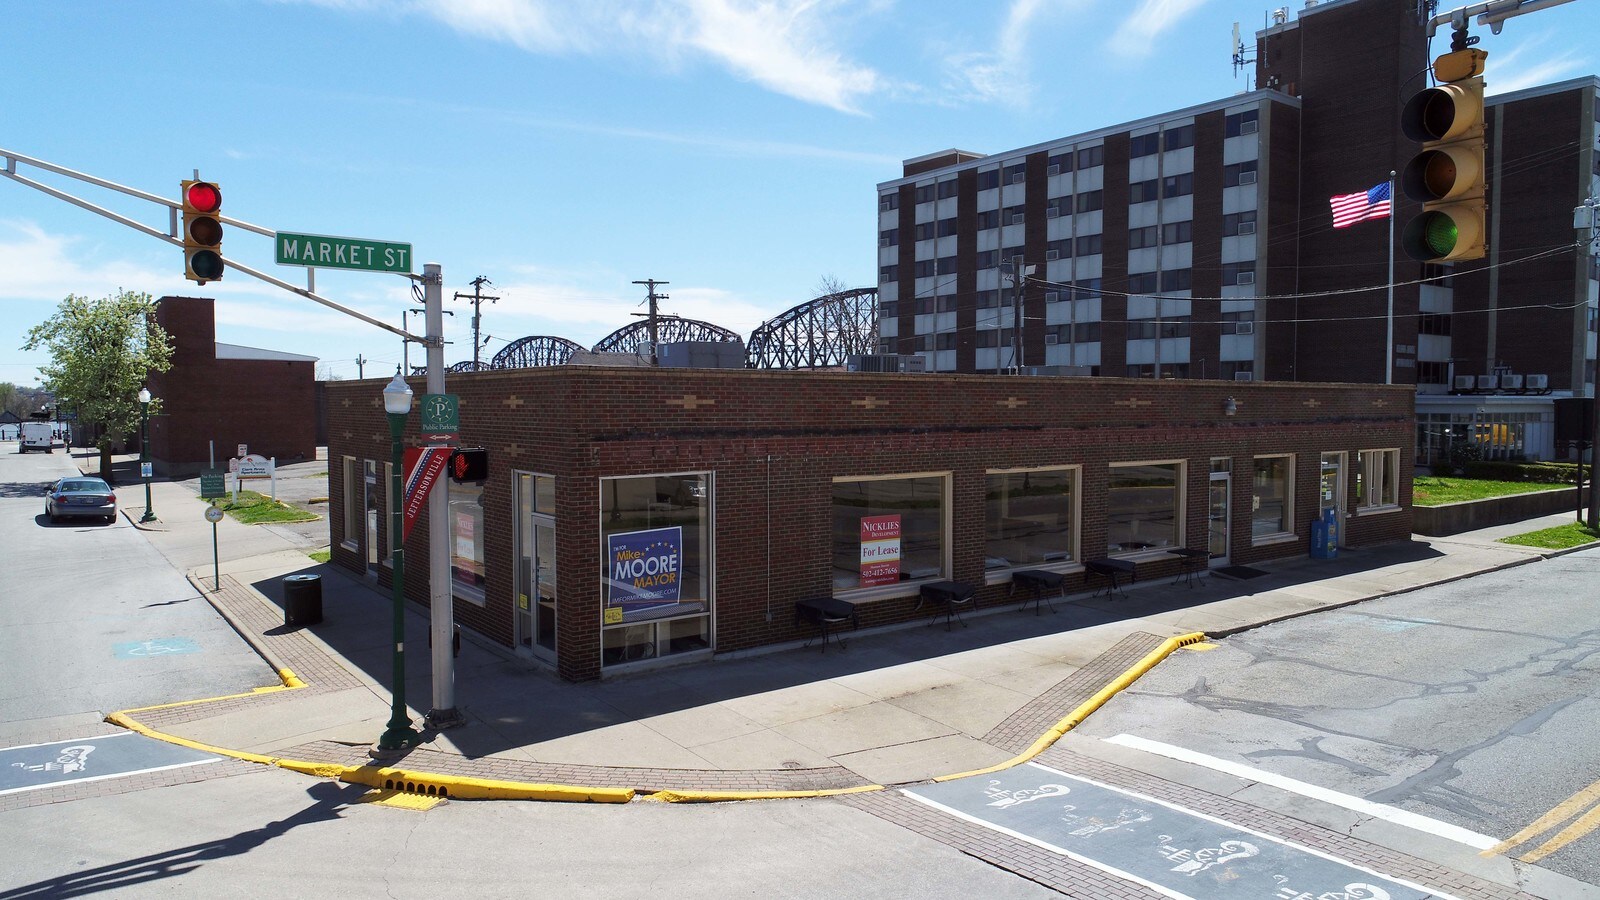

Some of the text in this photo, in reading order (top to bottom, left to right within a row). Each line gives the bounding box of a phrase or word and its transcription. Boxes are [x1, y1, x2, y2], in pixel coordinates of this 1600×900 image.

[283, 239, 407, 268] MARKET ST
[435, 403, 446, 417] P
[422, 423, 458, 432] Public Parking
[406, 454, 444, 519] JEFFERSONVILLE
[863, 521, 900, 532] NICKLIES
[616, 550, 641, 562] Mike
[863, 545, 899, 558] For Lease
[615, 553, 677, 580] MOORE
[862, 567, 898, 578] 502-412-7656
[633, 573, 676, 589] MAYOR
